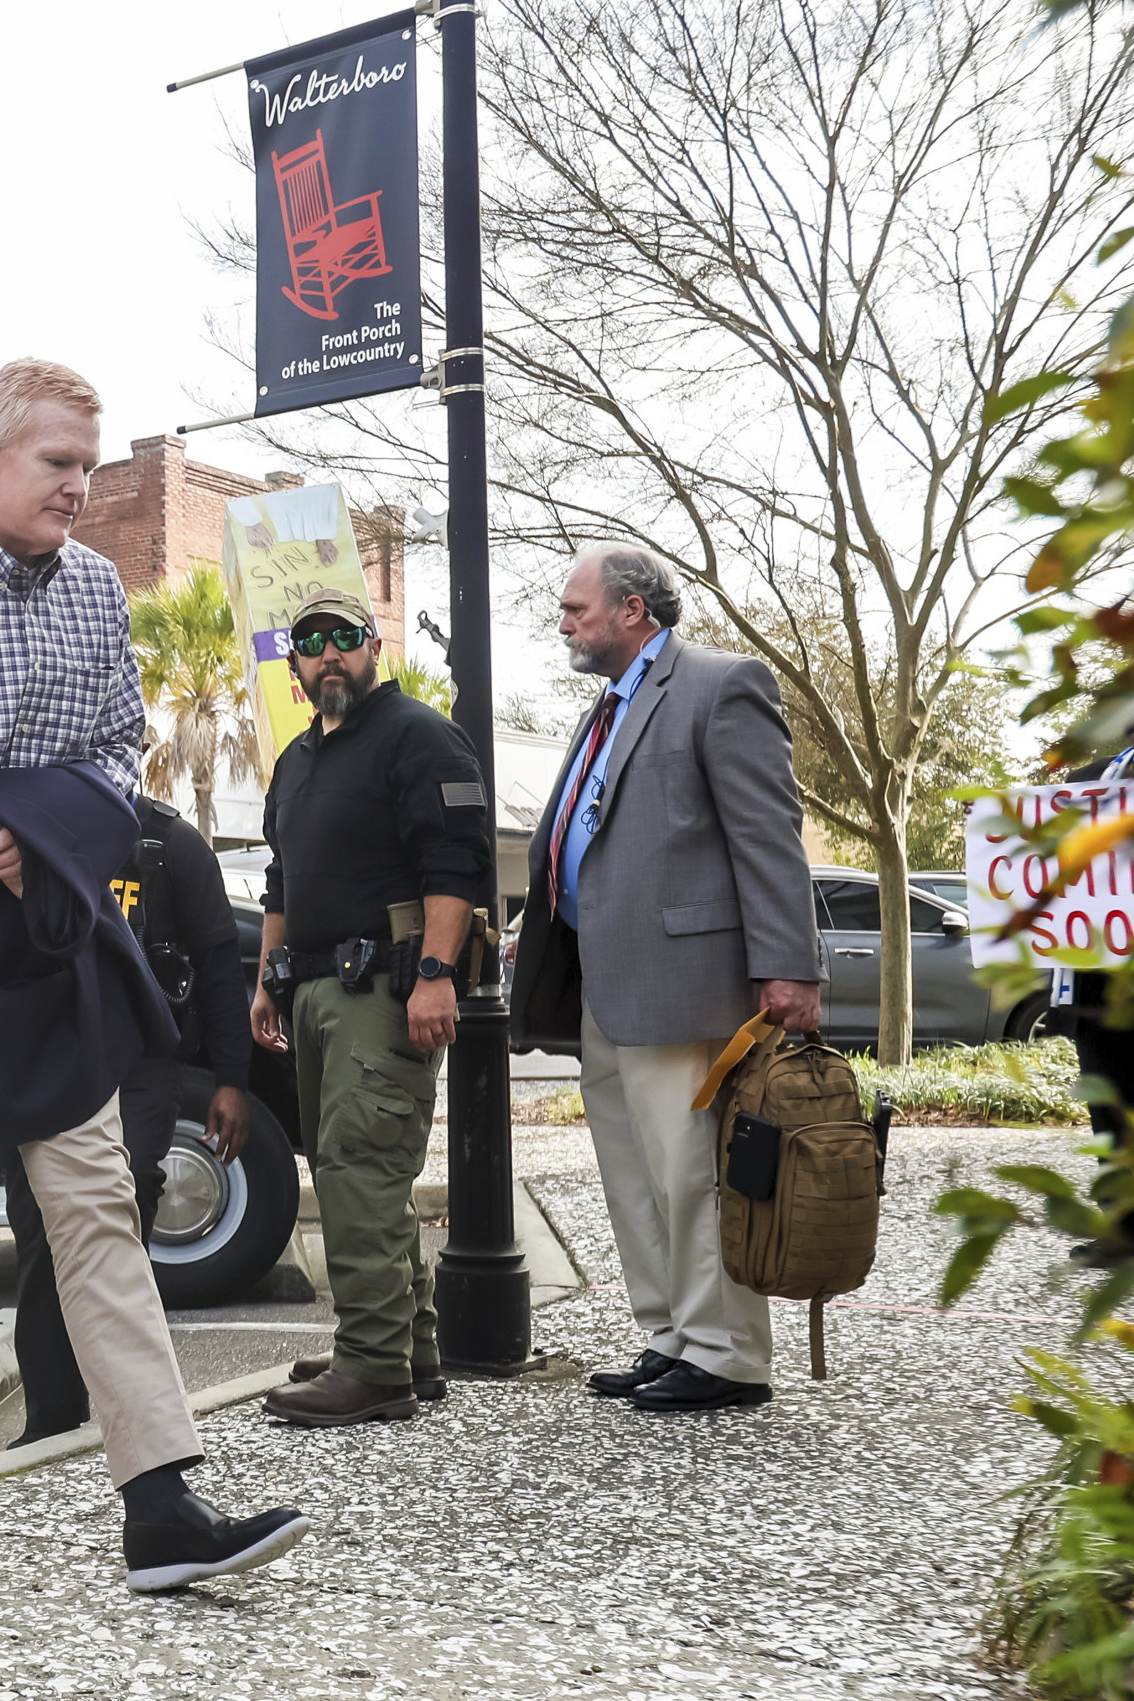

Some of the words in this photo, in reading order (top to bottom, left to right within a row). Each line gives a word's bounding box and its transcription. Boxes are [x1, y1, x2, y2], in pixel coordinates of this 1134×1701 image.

[255, 55, 407, 127] Walterboro
[374, 301, 401, 319] The
[321, 330, 358, 351] Front
[361, 319, 401, 342] Porch
[281, 361, 296, 379] of
[298, 358, 320, 376] the
[323, 341, 405, 370] Lowcountry
[250, 546, 310, 588] SIN
[988, 850, 1134, 900] COMI
